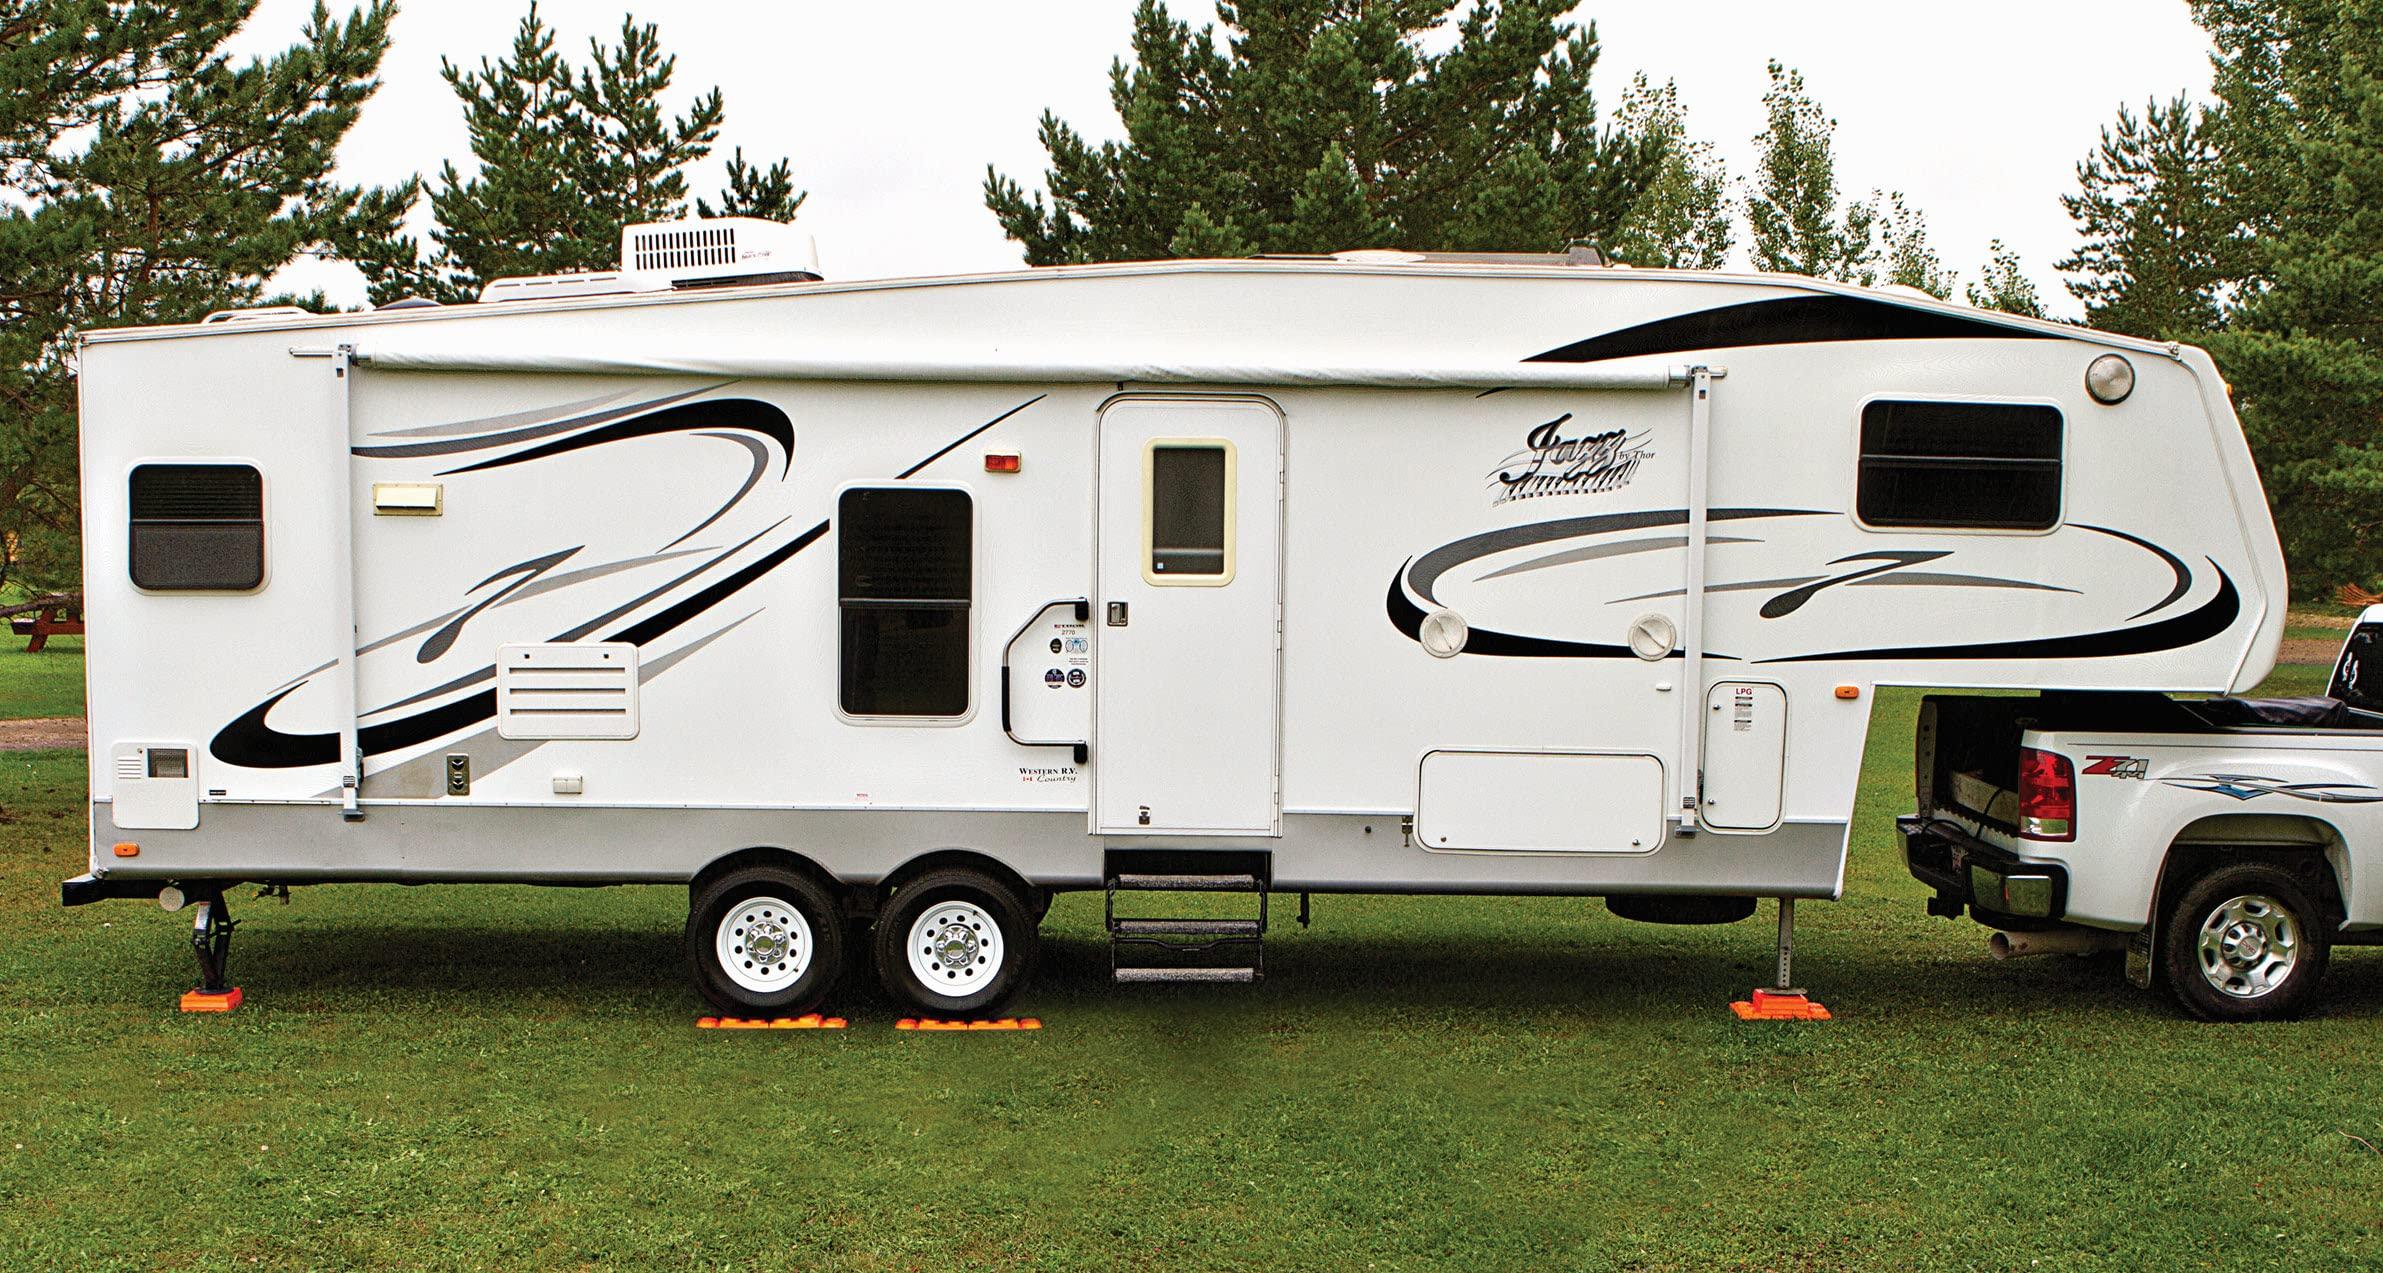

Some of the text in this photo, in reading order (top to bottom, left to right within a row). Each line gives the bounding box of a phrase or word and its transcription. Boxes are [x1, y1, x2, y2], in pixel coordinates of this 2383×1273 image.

[1619, 450, 1656, 461] by Thor
[1019, 767, 1078, 775] WESTERN R.V.
[1036, 775, 1077, 784] Country
